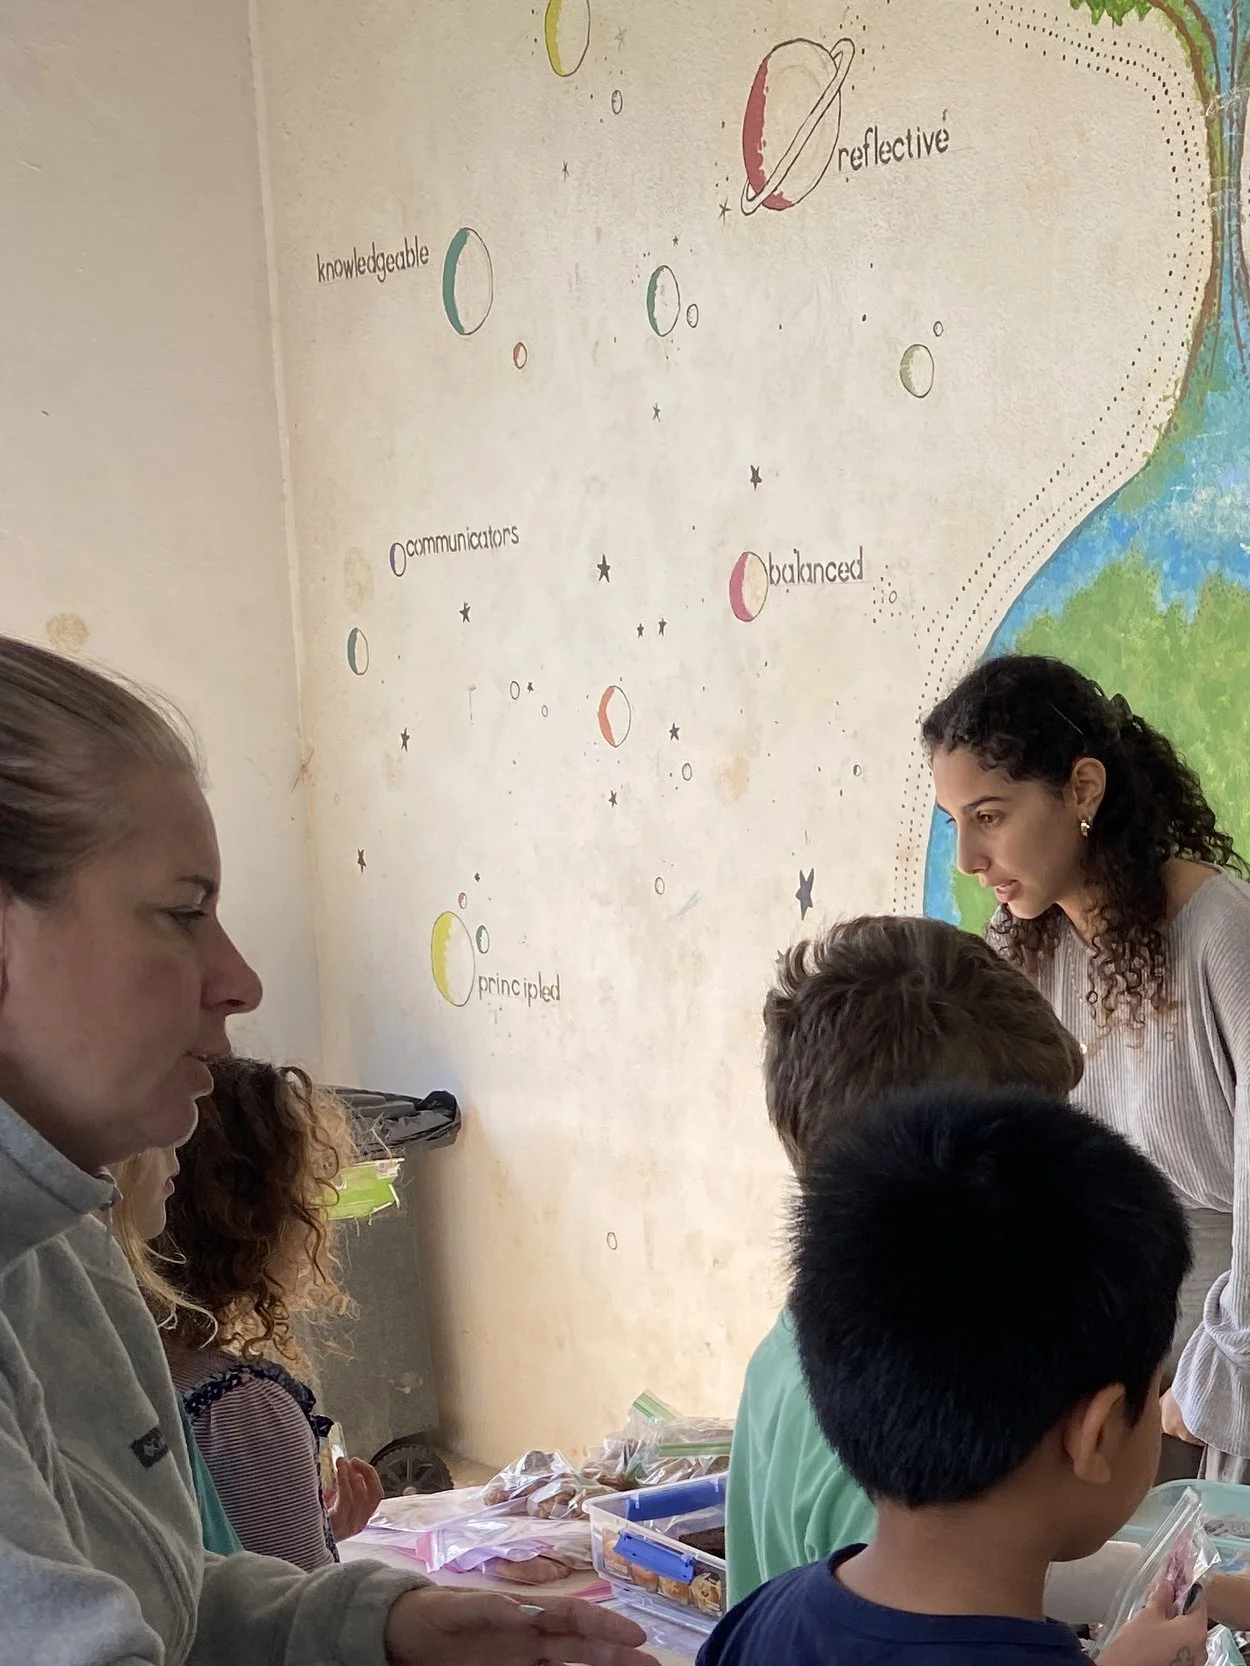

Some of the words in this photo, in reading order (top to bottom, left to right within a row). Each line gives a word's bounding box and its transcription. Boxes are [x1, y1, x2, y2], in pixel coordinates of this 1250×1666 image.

[838, 125, 949, 172] reflective
[316, 235, 429, 283] knowledgeable
[406, 525, 519, 557] communicators
[769, 545, 863, 586] balanced
[478, 971, 560, 1007] principled
